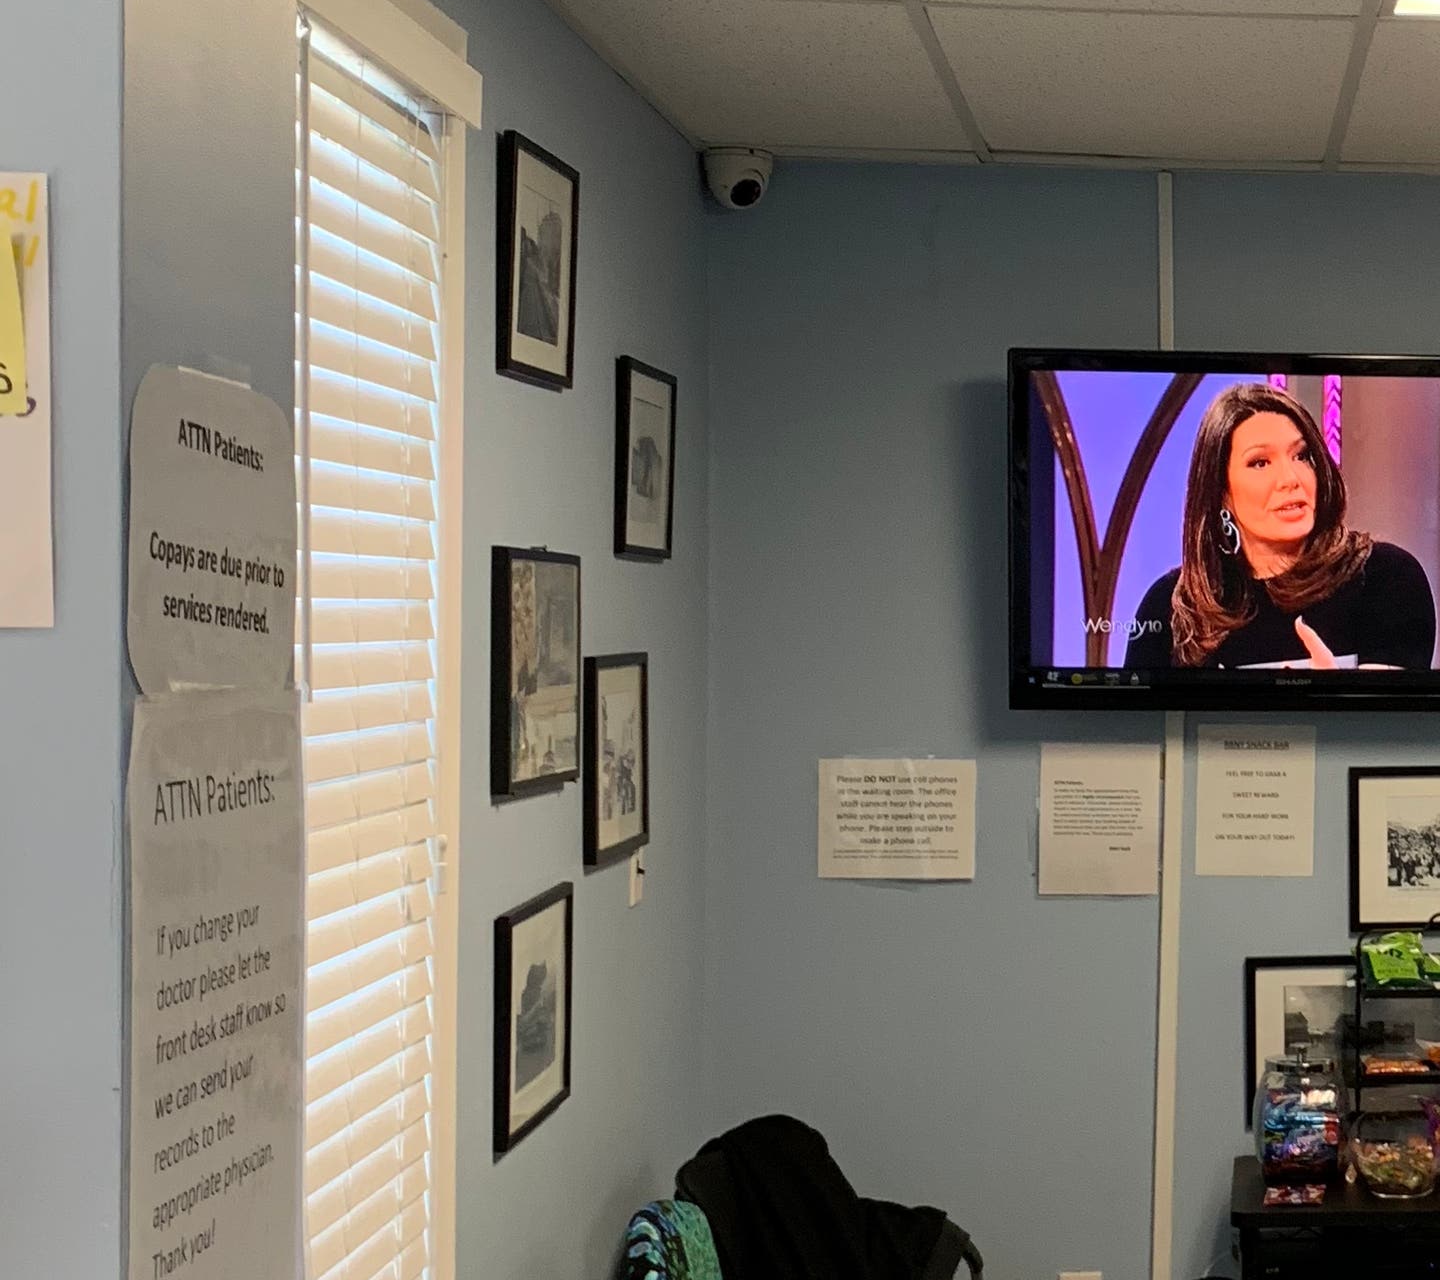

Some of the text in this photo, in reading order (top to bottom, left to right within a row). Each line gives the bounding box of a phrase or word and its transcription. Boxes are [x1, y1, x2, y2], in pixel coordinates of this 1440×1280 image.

[178, 418, 264, 471] ATTN Patients:
[150, 530, 285, 588] Copays are due prior to
[163, 593, 269, 634] services rendered.
[154, 769, 275, 825] ATTN Patients:
[863, 775, 896, 784] DO NOT
[156, 905, 260, 959] If you change your
[157, 947, 271, 1011] doctor please let the
[156, 992, 286, 1064] front desk staff know so
[155, 1054, 254, 1120] we can send your
[154, 1112, 235, 1173] records to the
[152, 1143, 274, 1231] appropriate physician.
[152, 1218, 216, 1280] Thank you!
